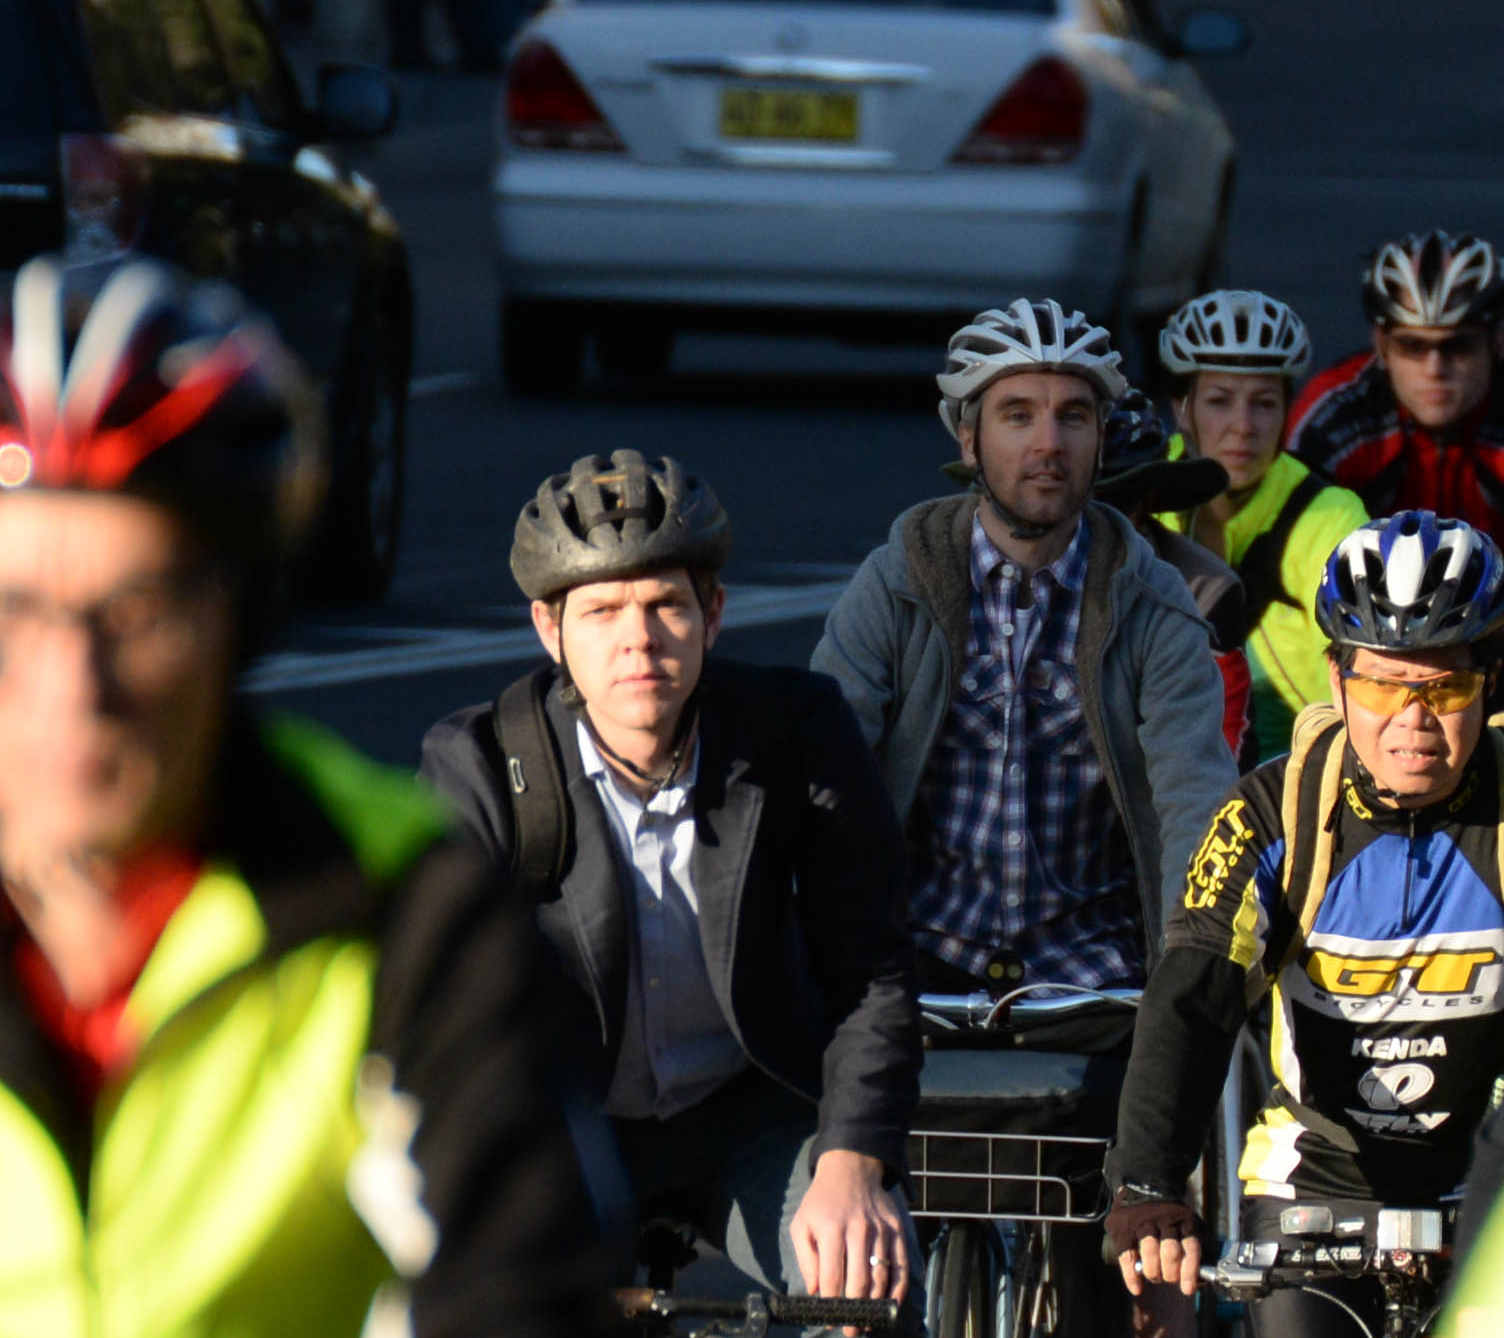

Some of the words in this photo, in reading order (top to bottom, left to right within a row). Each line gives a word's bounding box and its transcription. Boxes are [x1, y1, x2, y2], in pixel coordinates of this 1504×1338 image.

[1299, 947, 1503, 997] GT
[1313, 992, 1485, 1011] BICYCLES
[1350, 1034, 1448, 1061] KENDA
